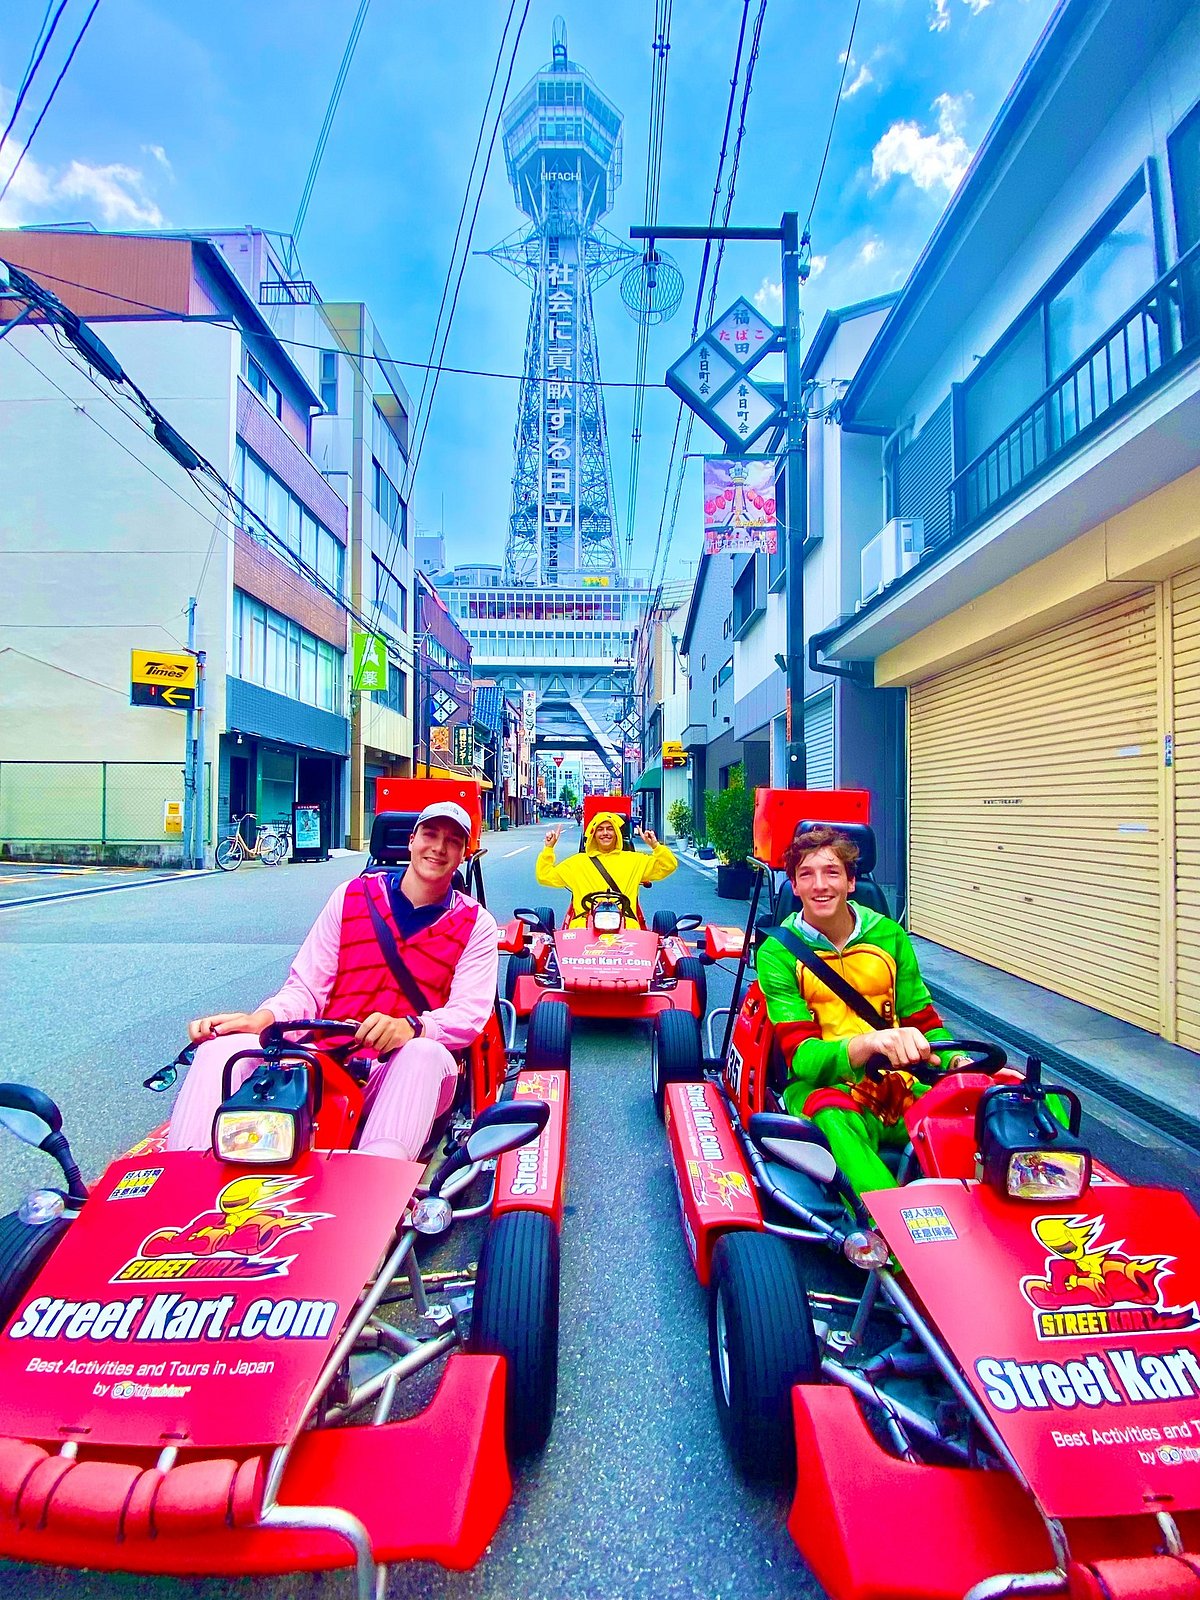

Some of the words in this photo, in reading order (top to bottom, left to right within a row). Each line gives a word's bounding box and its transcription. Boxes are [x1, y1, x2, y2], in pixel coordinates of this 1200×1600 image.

[541, 172, 582, 181] HITACHI
[719, 328, 765, 341] たばこ
[698, 346, 711, 395] 春日町会
[544, 262, 574, 528] 社会に貢献する日立
[737, 384, 750, 434] 春日町会
[144, 661, 187, 678] Times
[362, 670, 378, 687] 薬
[561, 956, 597, 965] Street
[510, 1150, 540, 1195] Street
[903, 1207, 944, 1219] 対人対物
[9, 1296, 144, 1340] Street
[25, 1357, 65, 1374] Best
[64, 1359, 135, 1376] Activities
[136, 1361, 166, 1376] and
[169, 1361, 210, 1376] Tours
[212, 1360, 227, 1376] in
[229, 1359, 275, 1377] Japan
[977, 1356, 1121, 1410] Street
[1107, 1348, 1200, 1403] Kart
[93, 1382, 110, 1397] by
[1051, 1430, 1090, 1448] Best
[1091, 1425, 1162, 1446] Activities
[1163, 1421, 1192, 1438] and
[1138, 1450, 1156, 1466] by
